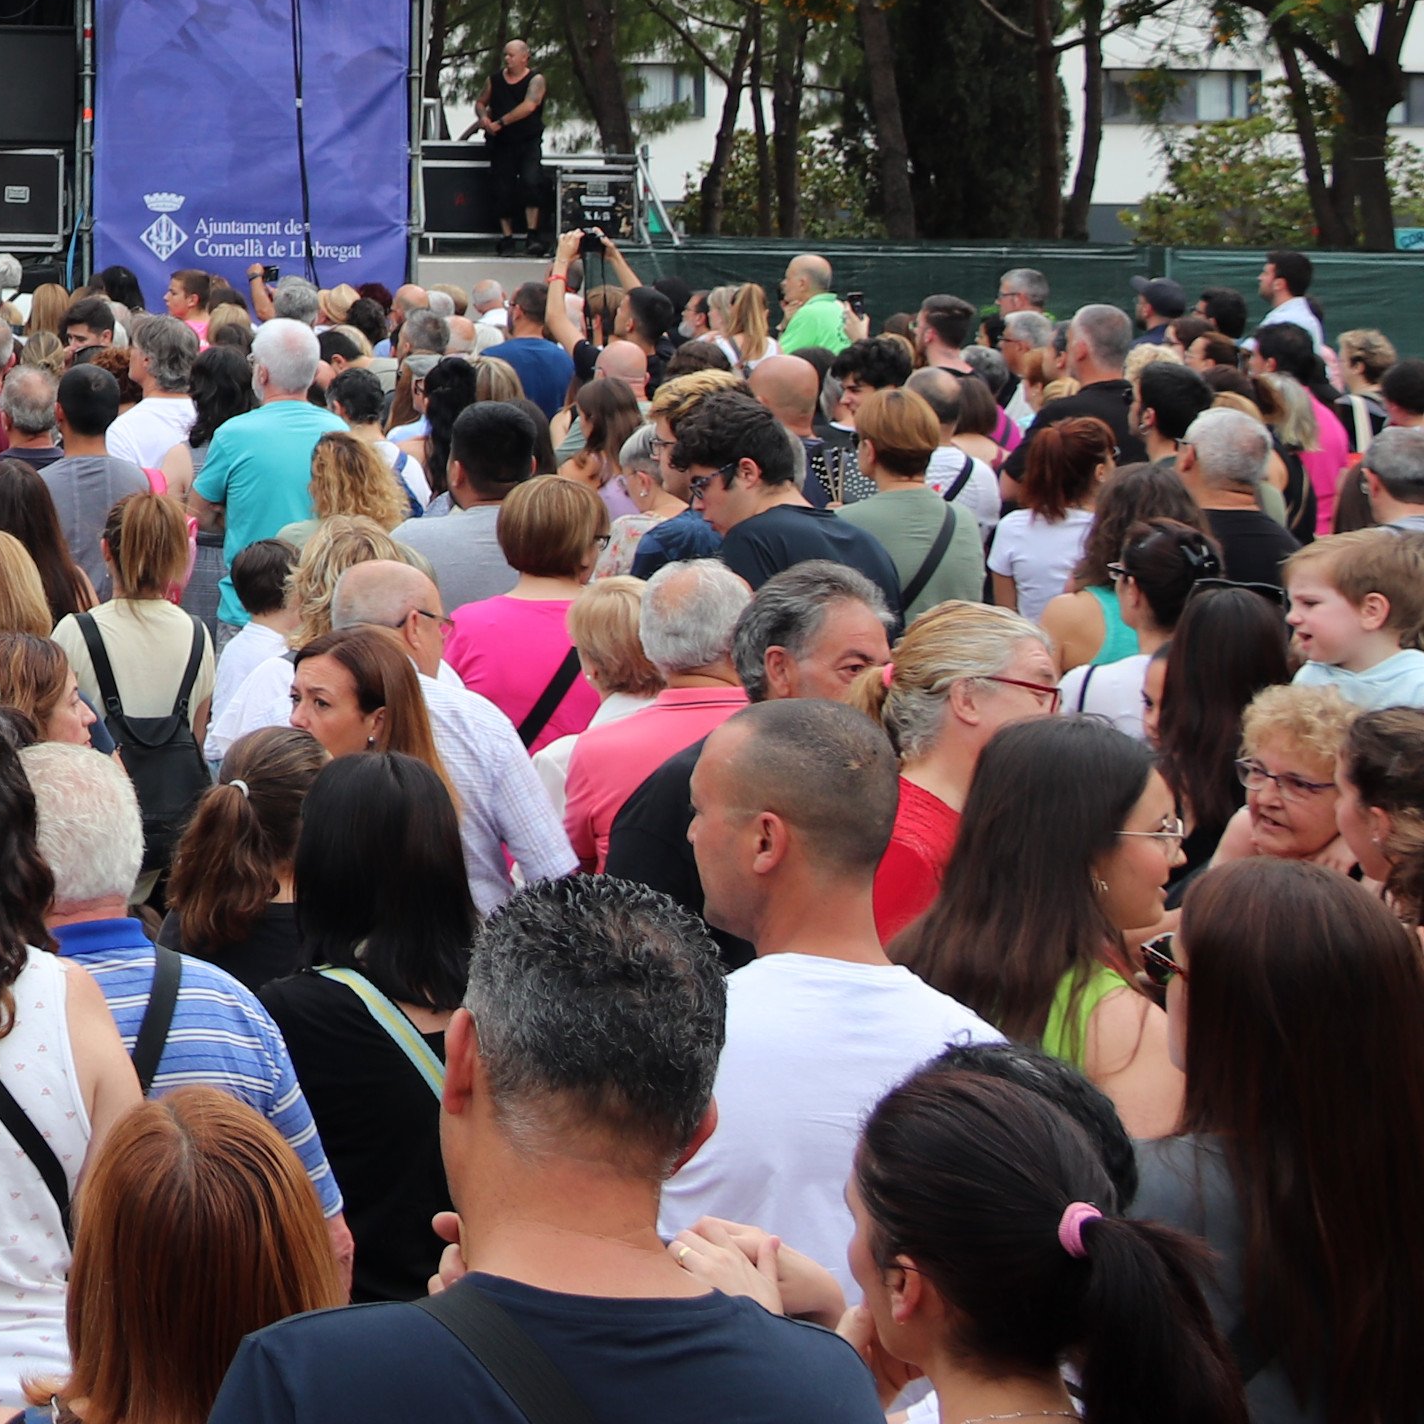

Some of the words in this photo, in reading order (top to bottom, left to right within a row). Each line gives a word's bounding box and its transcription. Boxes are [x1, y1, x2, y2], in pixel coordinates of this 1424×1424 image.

[195, 217, 281, 238] Ajuntament
[284, 219, 302, 235] de
[194, 239, 264, 257] Cornellà
[267, 241, 286, 258] de
